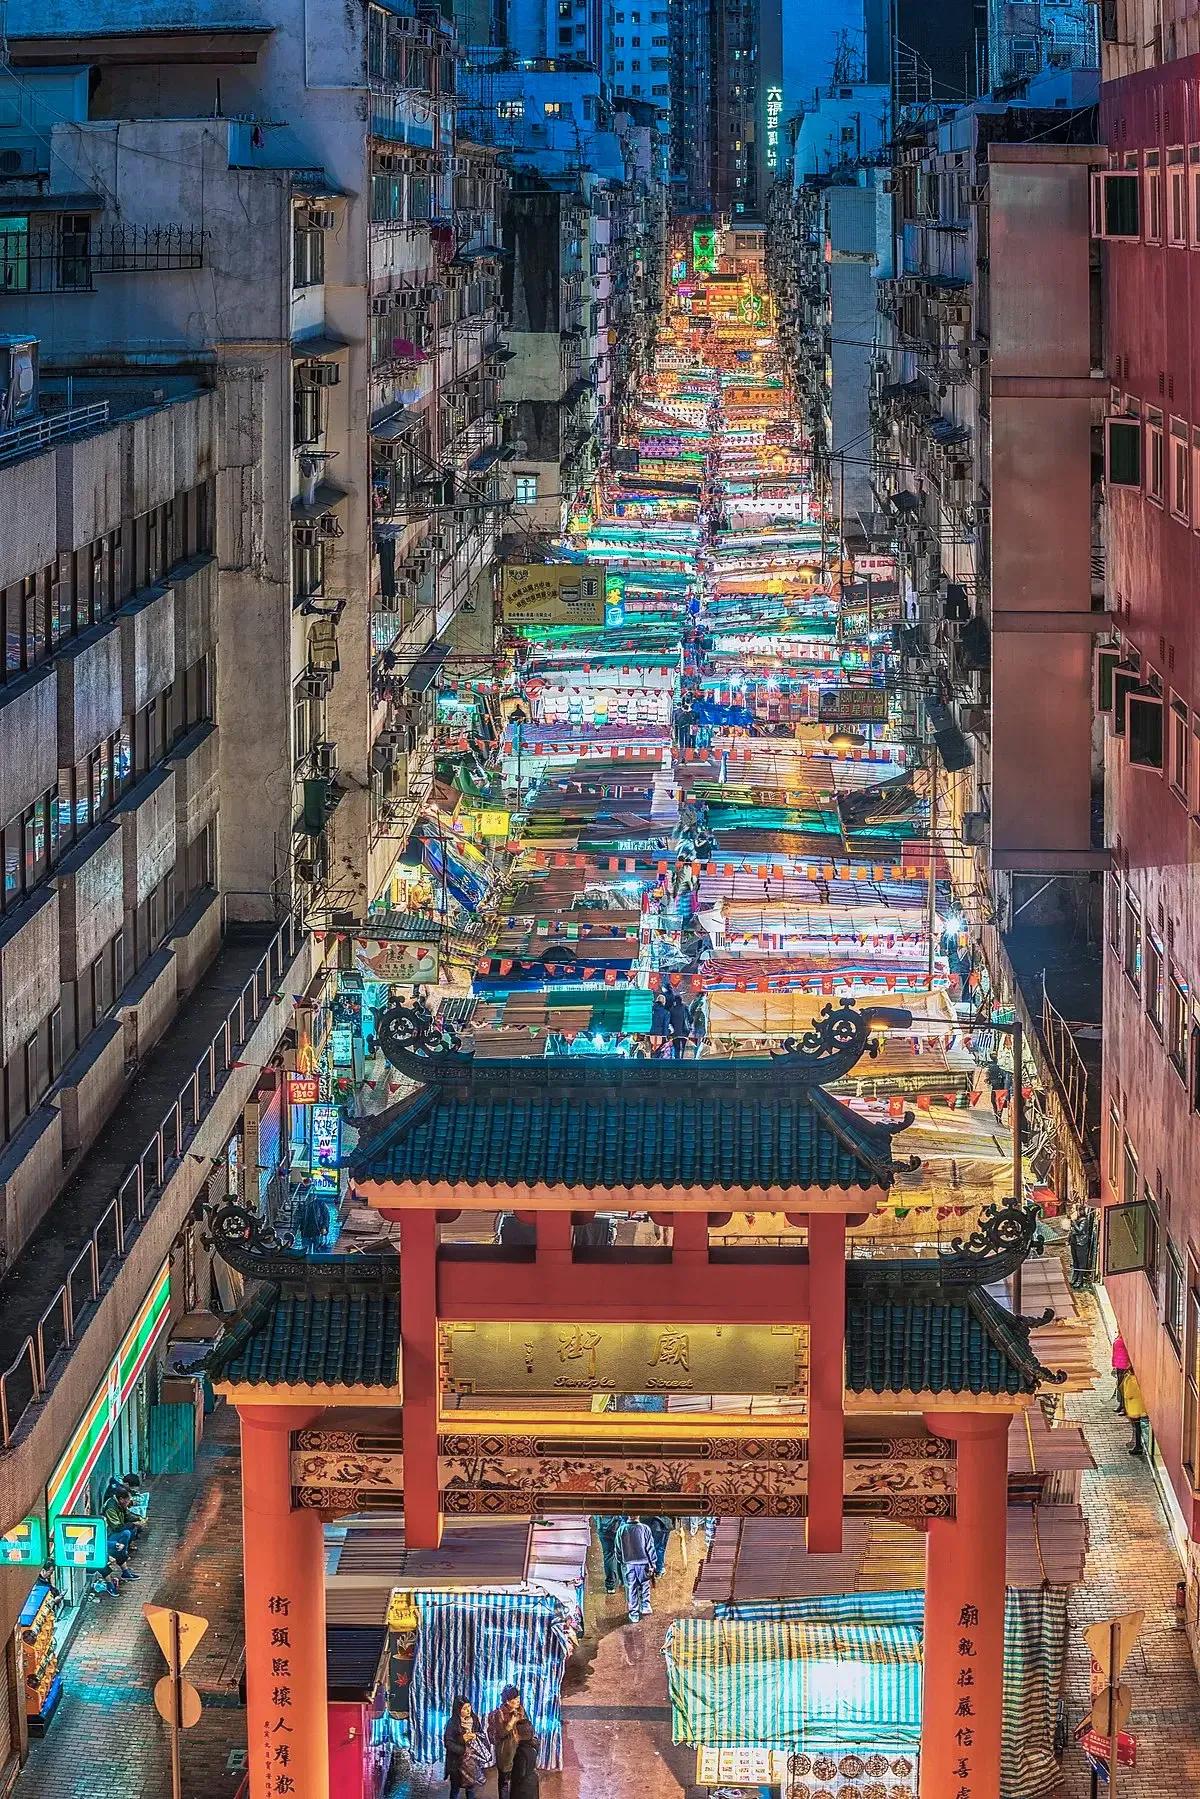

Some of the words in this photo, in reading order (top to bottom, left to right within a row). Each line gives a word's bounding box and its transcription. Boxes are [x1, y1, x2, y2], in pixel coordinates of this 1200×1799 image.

[290, 1082, 316, 1091] DVD
[553, 1376, 616, 1390] Temple
[645, 1376, 694, 1389] Street
[66, 1526, 94, 1564] 7
